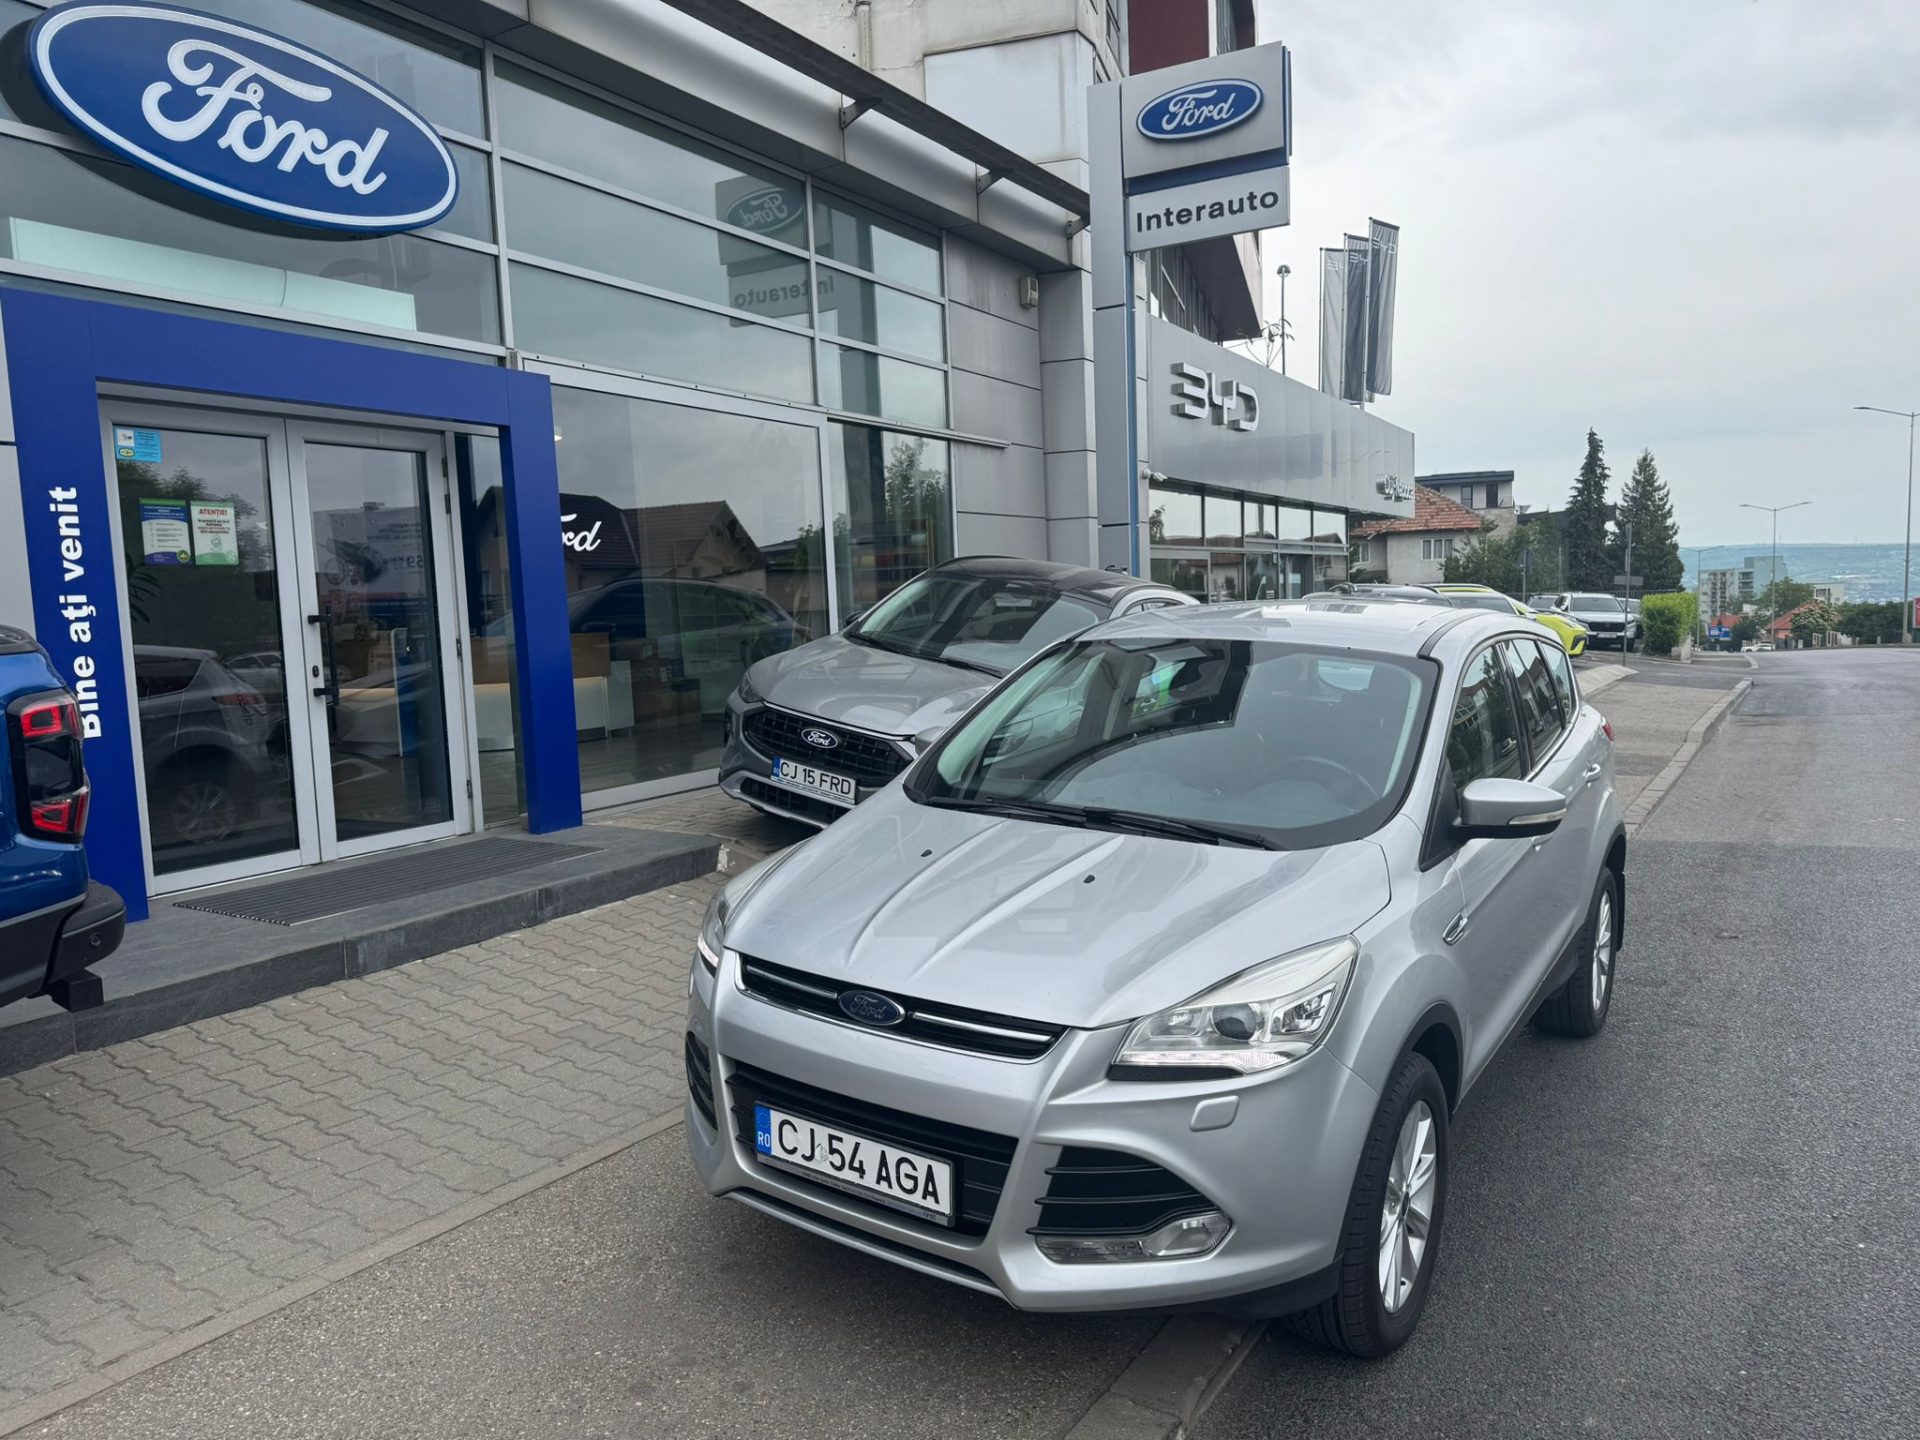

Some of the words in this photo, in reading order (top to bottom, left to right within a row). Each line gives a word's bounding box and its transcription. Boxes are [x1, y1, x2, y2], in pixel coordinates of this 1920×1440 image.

[142, 39, 389, 195] Ford
[1162, 89, 1236, 131] Ford
[1137, 191, 1279, 233] Interauto
[1171, 362, 1259, 432] BYD
[49, 487, 83, 582] venit
[807, 731, 831, 746] Ford
[780, 762, 798, 779] CJ
[802, 768, 815, 785] 15
[819, 773, 852, 795] FRD
[850, 995, 887, 1018] Ford
[757, 1131, 770, 1147] RO
[778, 1119, 815, 1162] CJ
[828, 1133, 866, 1179] 54
[875, 1150, 940, 1204] AGA
